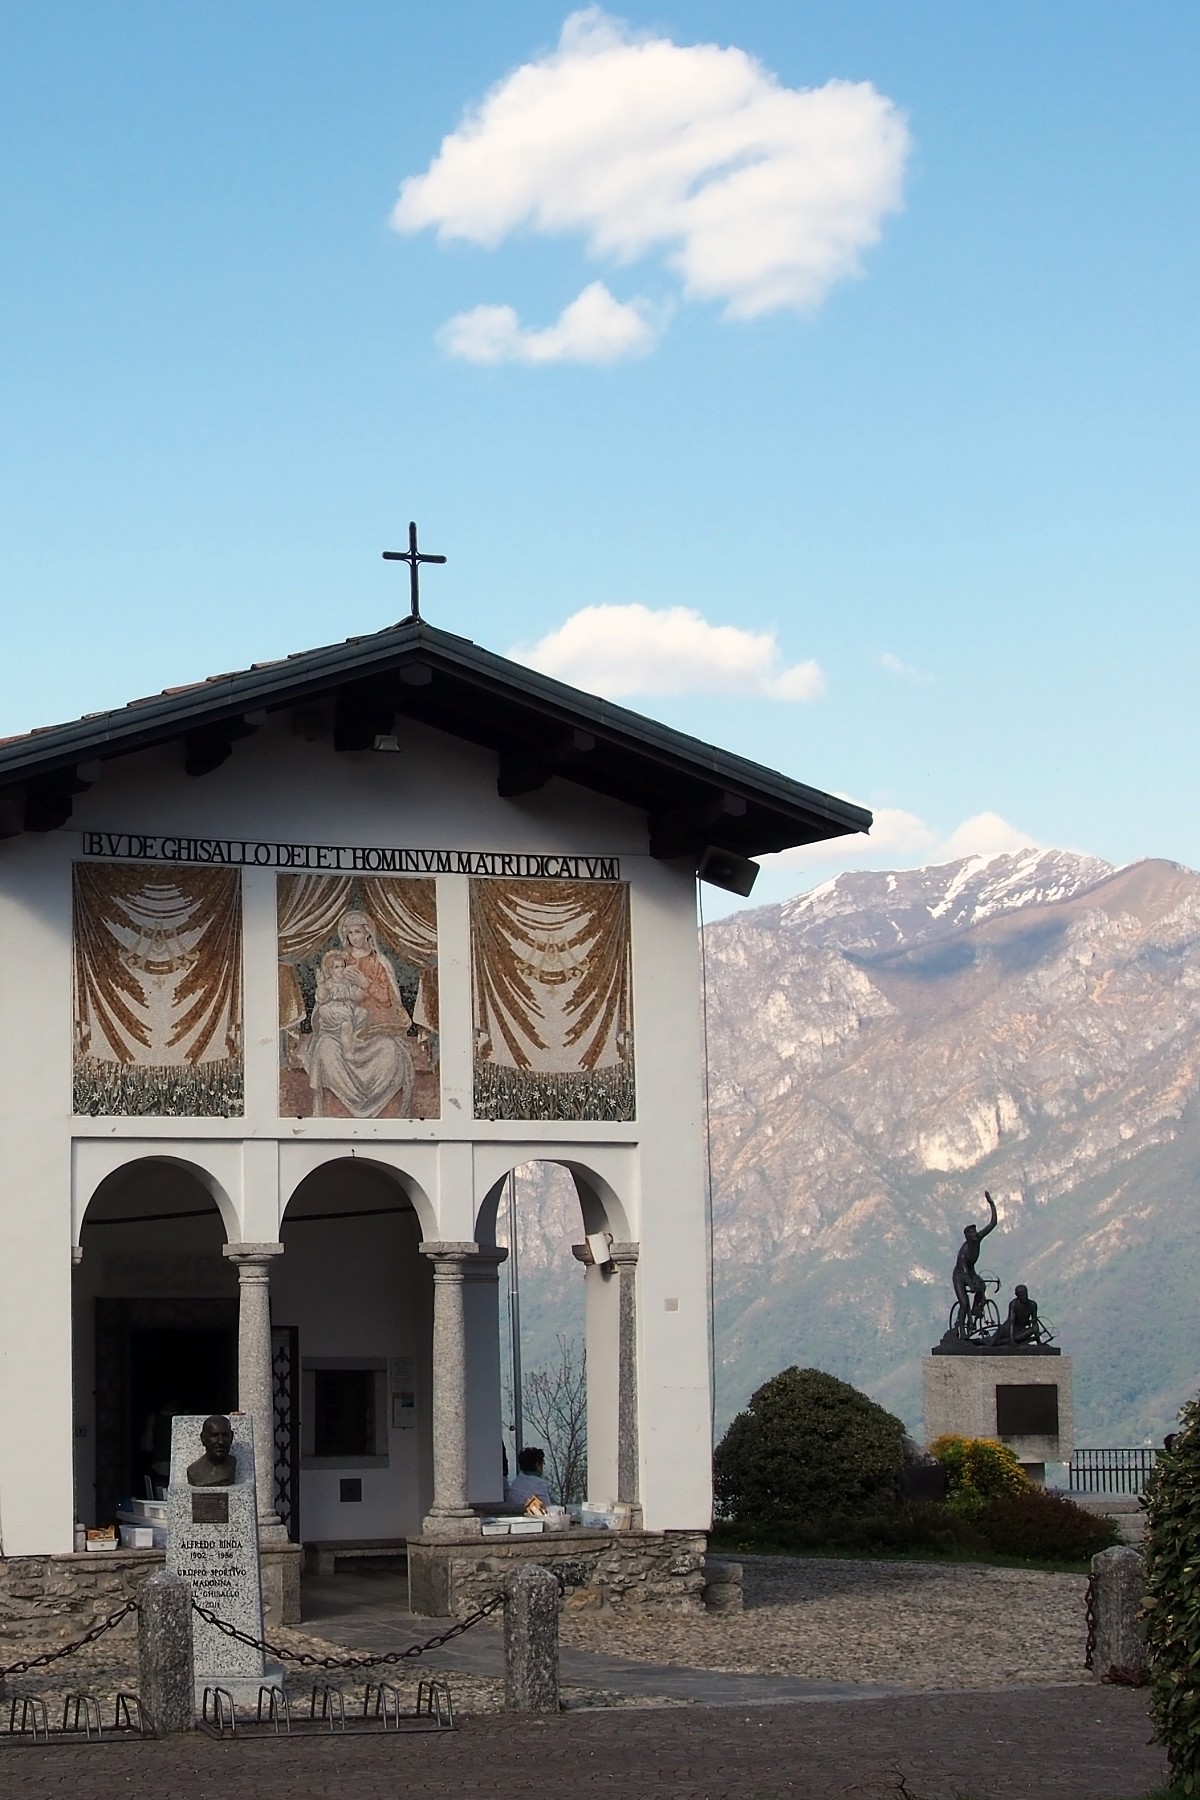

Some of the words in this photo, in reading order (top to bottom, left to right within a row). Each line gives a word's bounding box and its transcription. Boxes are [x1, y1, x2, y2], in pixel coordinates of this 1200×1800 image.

[161, 837, 271, 866] GHISALLO
[352, 848, 452, 873] HOMINVM
[181, 1540, 216, 1549] ALFREDO
[219, 1540, 243, 1549] BINDA
[218, 1551, 234, 1559] 1986
[177, 1568, 207, 1577] GRUPPO
[210, 1568, 247, 1577] SPORTIVO
[192, 1579, 232, 1587] MADONNA
[202, 1590, 240, 1598] GHISALLO
